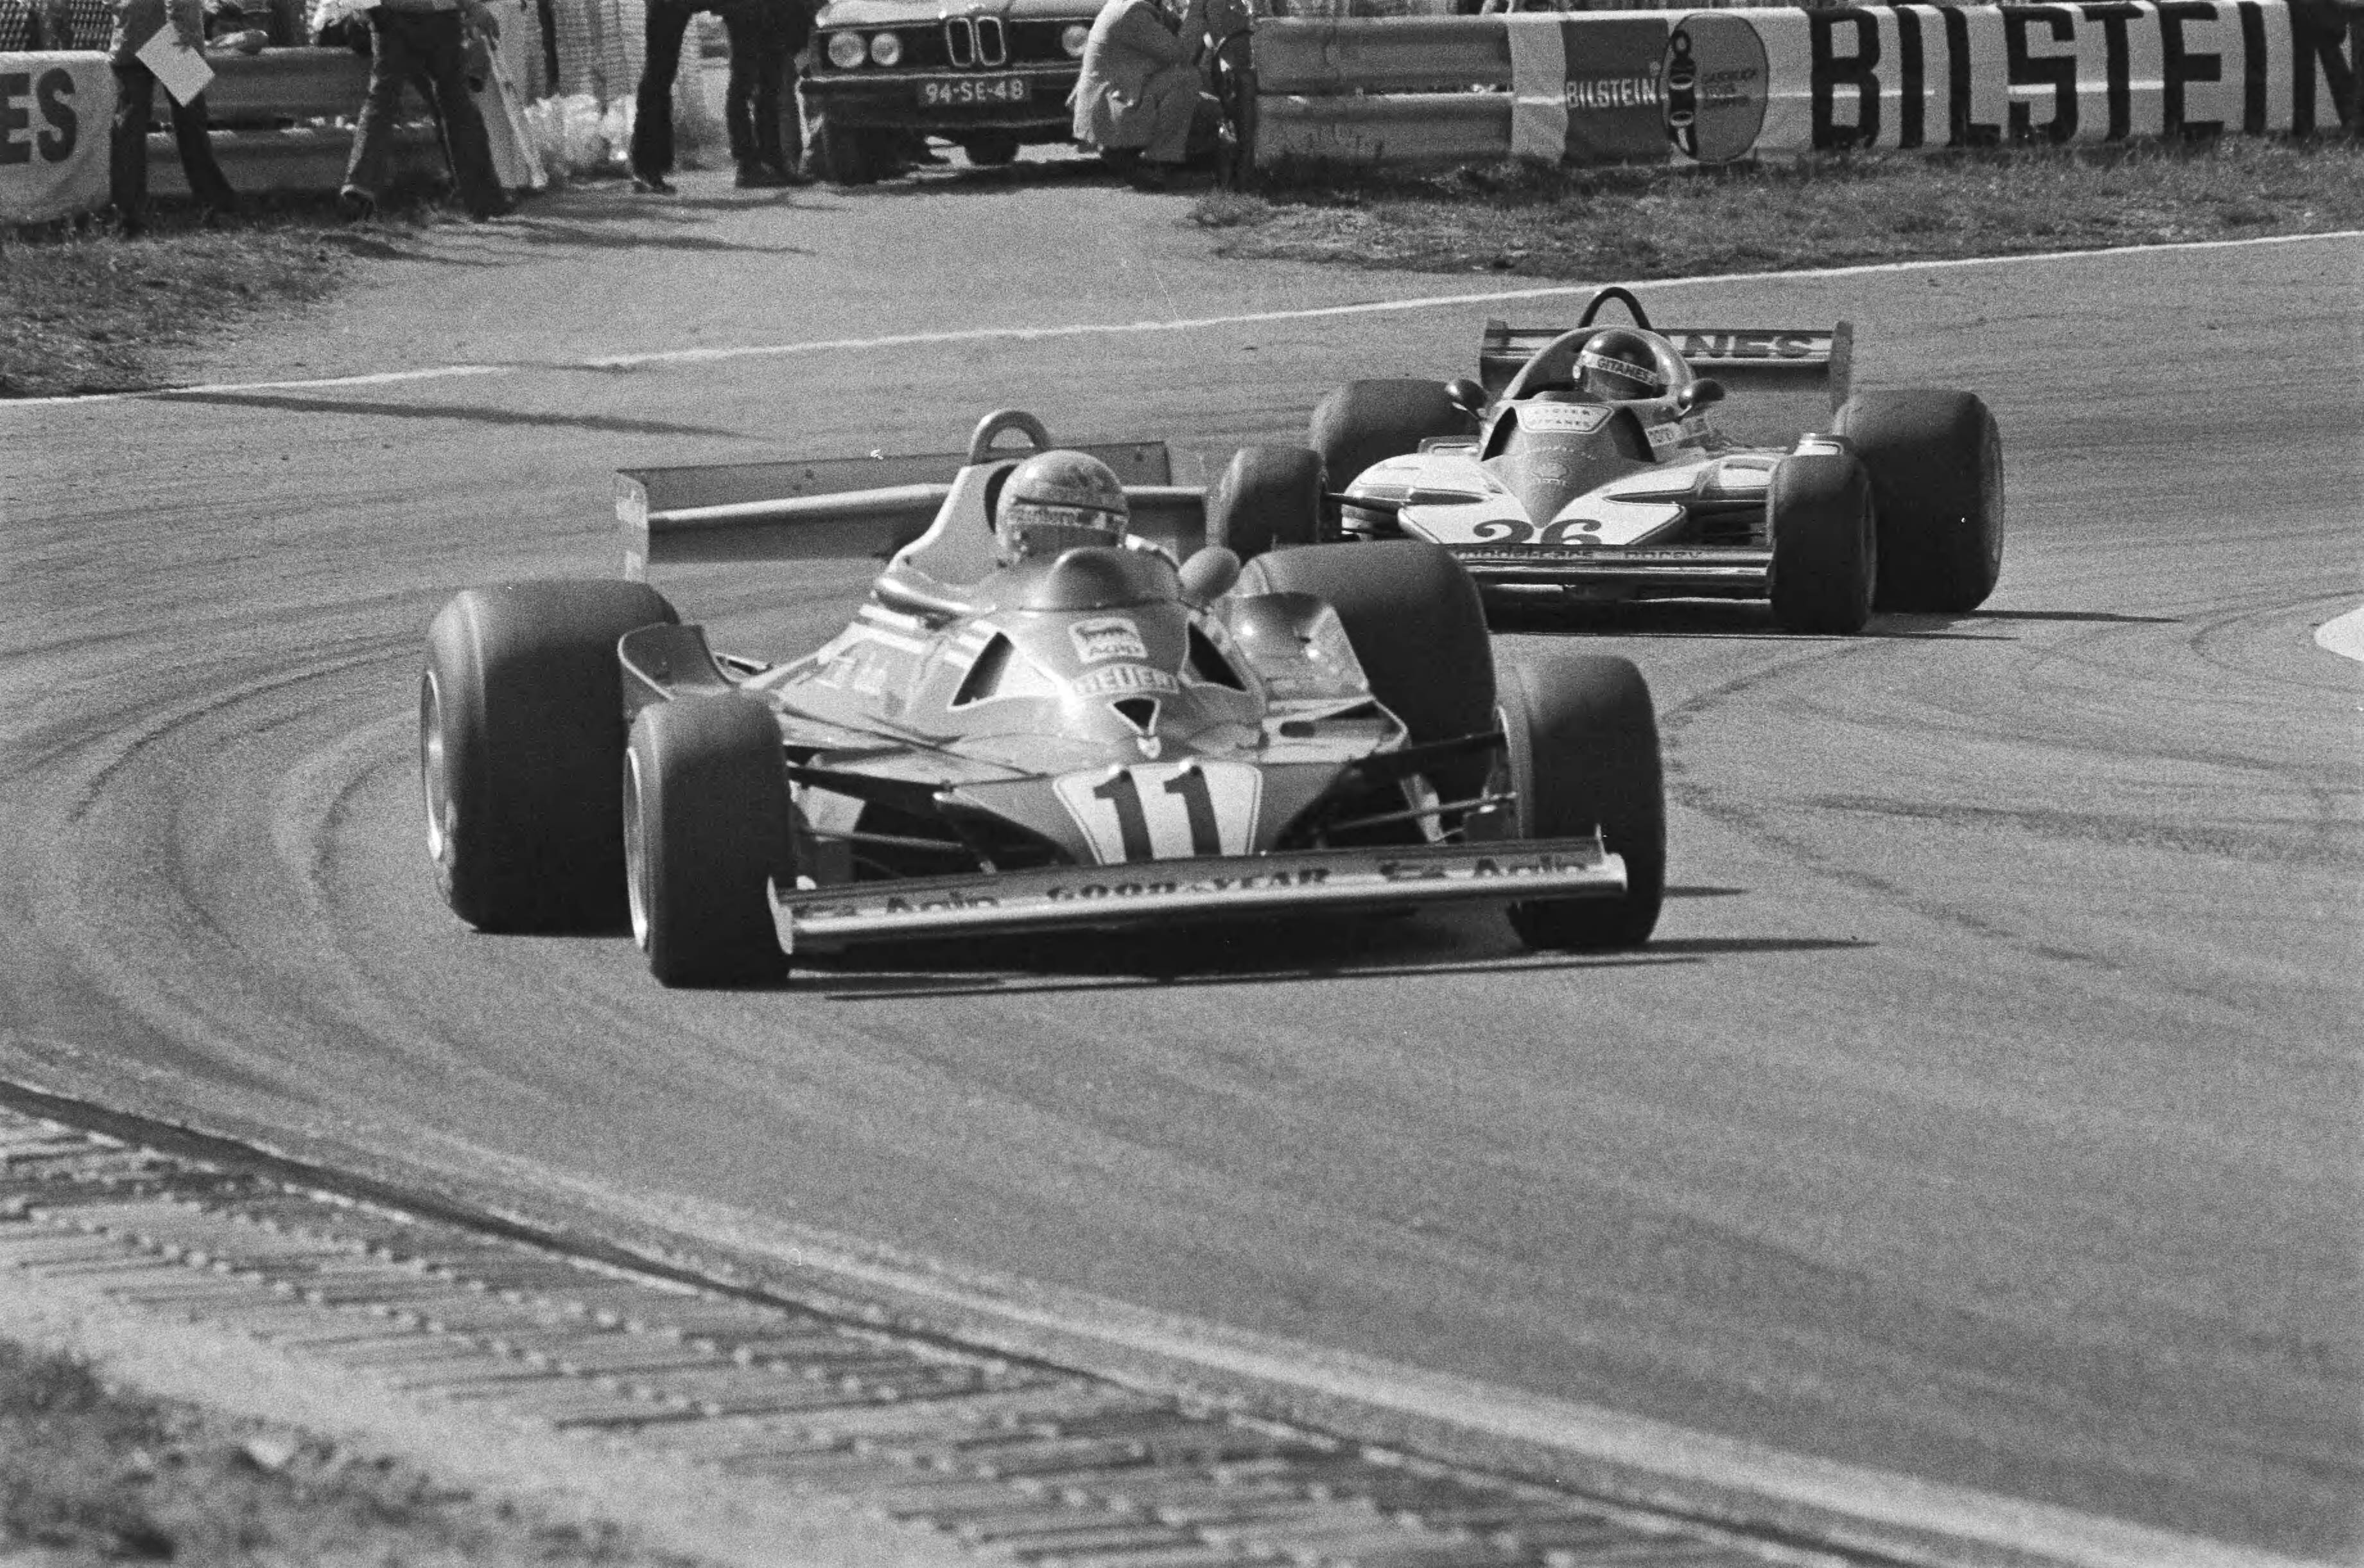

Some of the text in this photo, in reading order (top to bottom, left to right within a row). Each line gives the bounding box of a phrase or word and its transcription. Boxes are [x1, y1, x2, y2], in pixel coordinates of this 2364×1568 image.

[1810, 3, 2364, 148] BILSTEIN
[1567, 77, 1657, 109] BILSTEIN
[1597, 357, 1649, 381] GITANES
[1473, 519, 1603, 545] 26
[1093, 764, 1222, 863] 11
